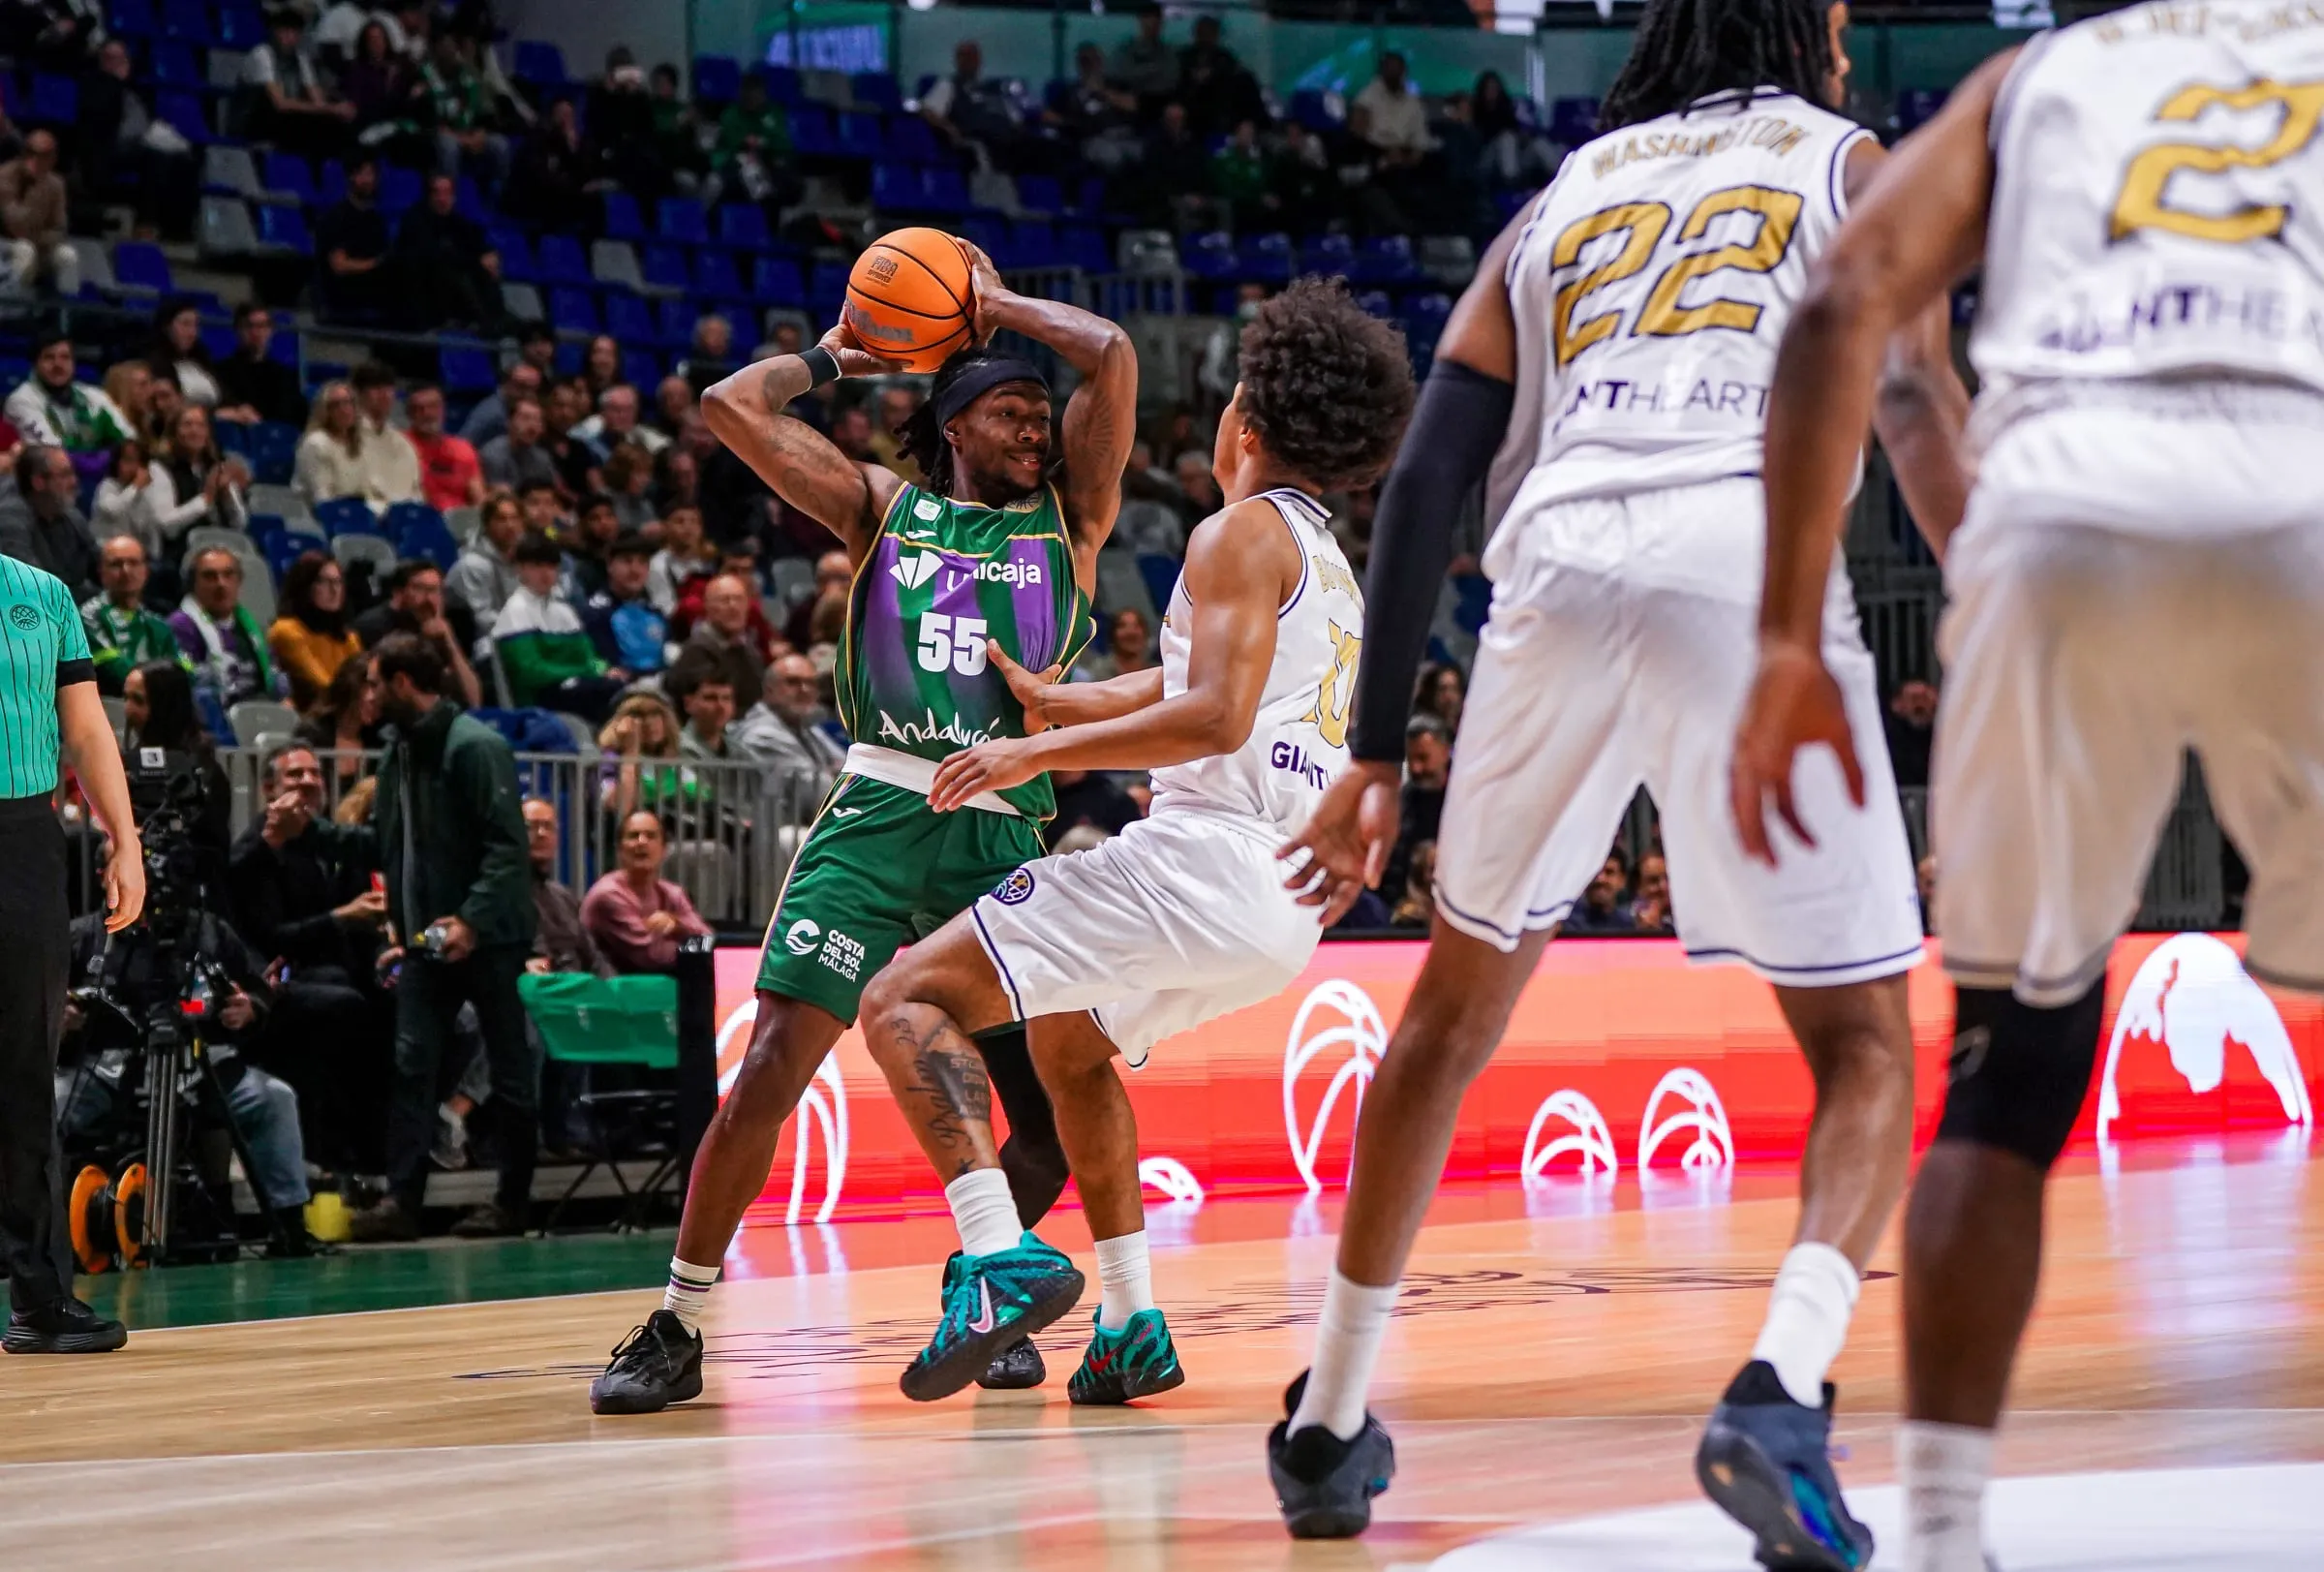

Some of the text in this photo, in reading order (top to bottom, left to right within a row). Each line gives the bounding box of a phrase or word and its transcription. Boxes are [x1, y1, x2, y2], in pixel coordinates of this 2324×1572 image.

[1550, 184, 1805, 373] 22
[917, 611, 988, 676] 55
[822, 941, 861, 972] DEL SOL
[828, 929, 865, 960] COSTA
